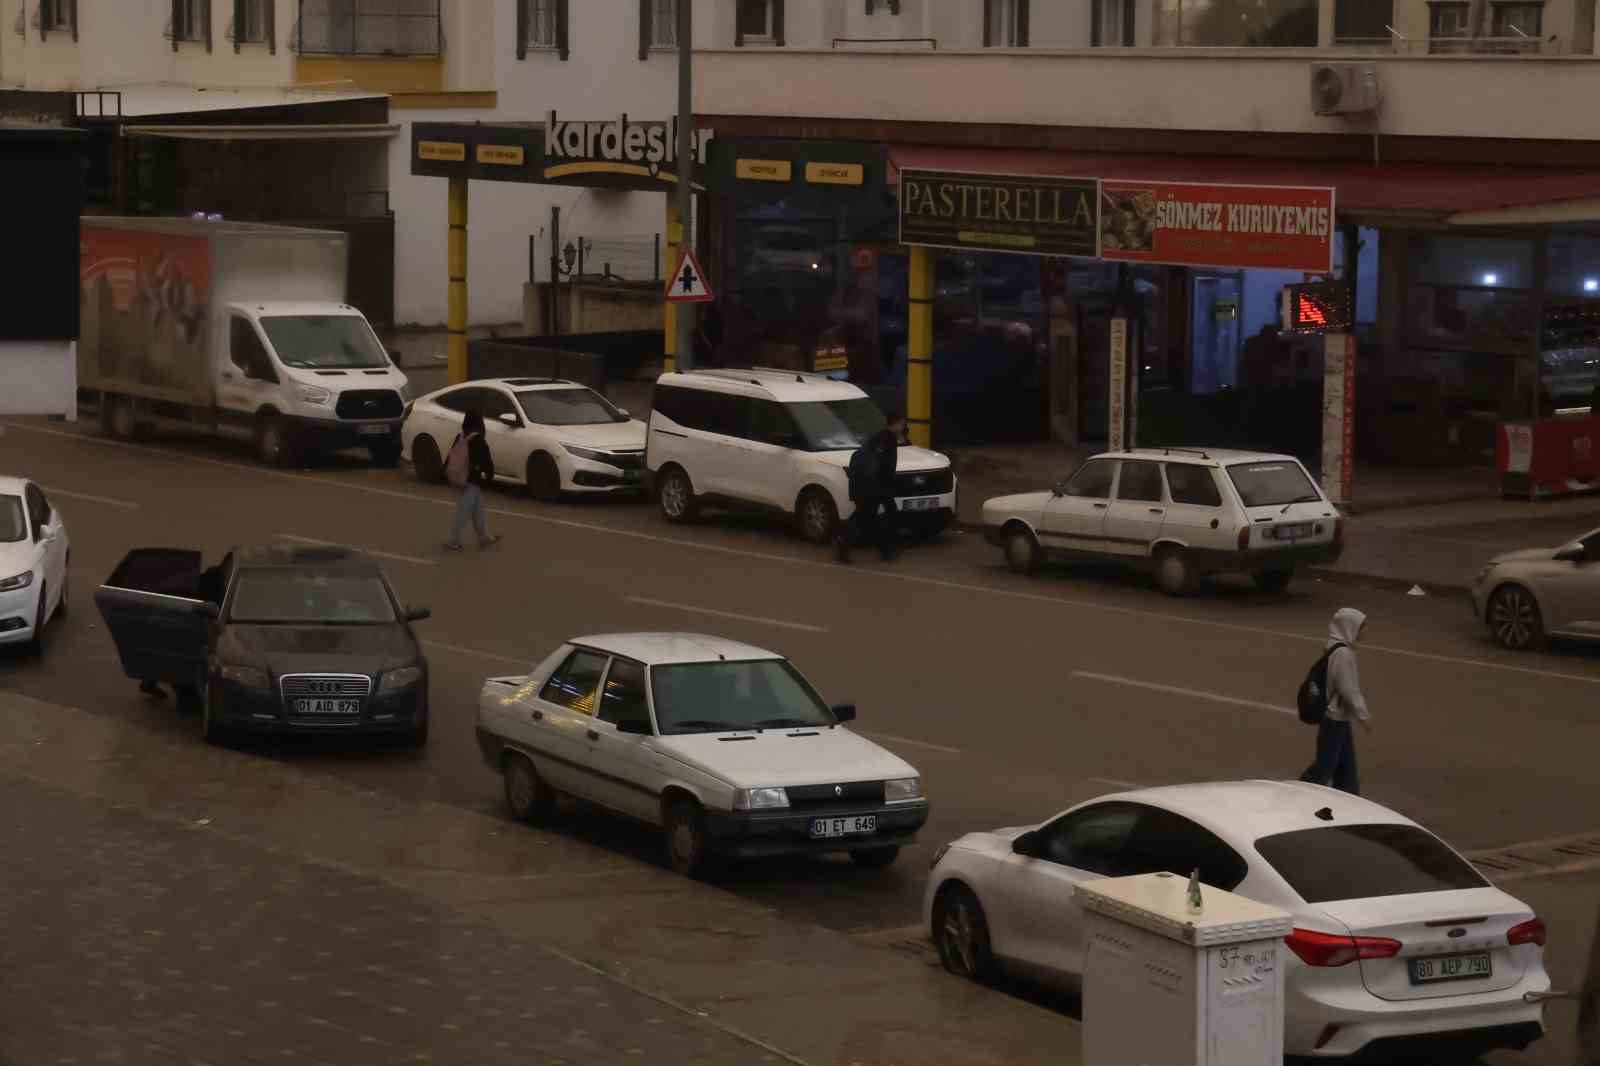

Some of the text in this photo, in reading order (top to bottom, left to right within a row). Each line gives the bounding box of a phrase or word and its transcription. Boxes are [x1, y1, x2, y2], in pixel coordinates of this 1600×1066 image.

[903, 181, 1093, 225] PASTERELLA
[1156, 192, 1328, 244] SÖNMEZ KURUYEMİŞ
[298, 700, 310, 712] 01
[815, 816, 875, 833] 01 ET 649
